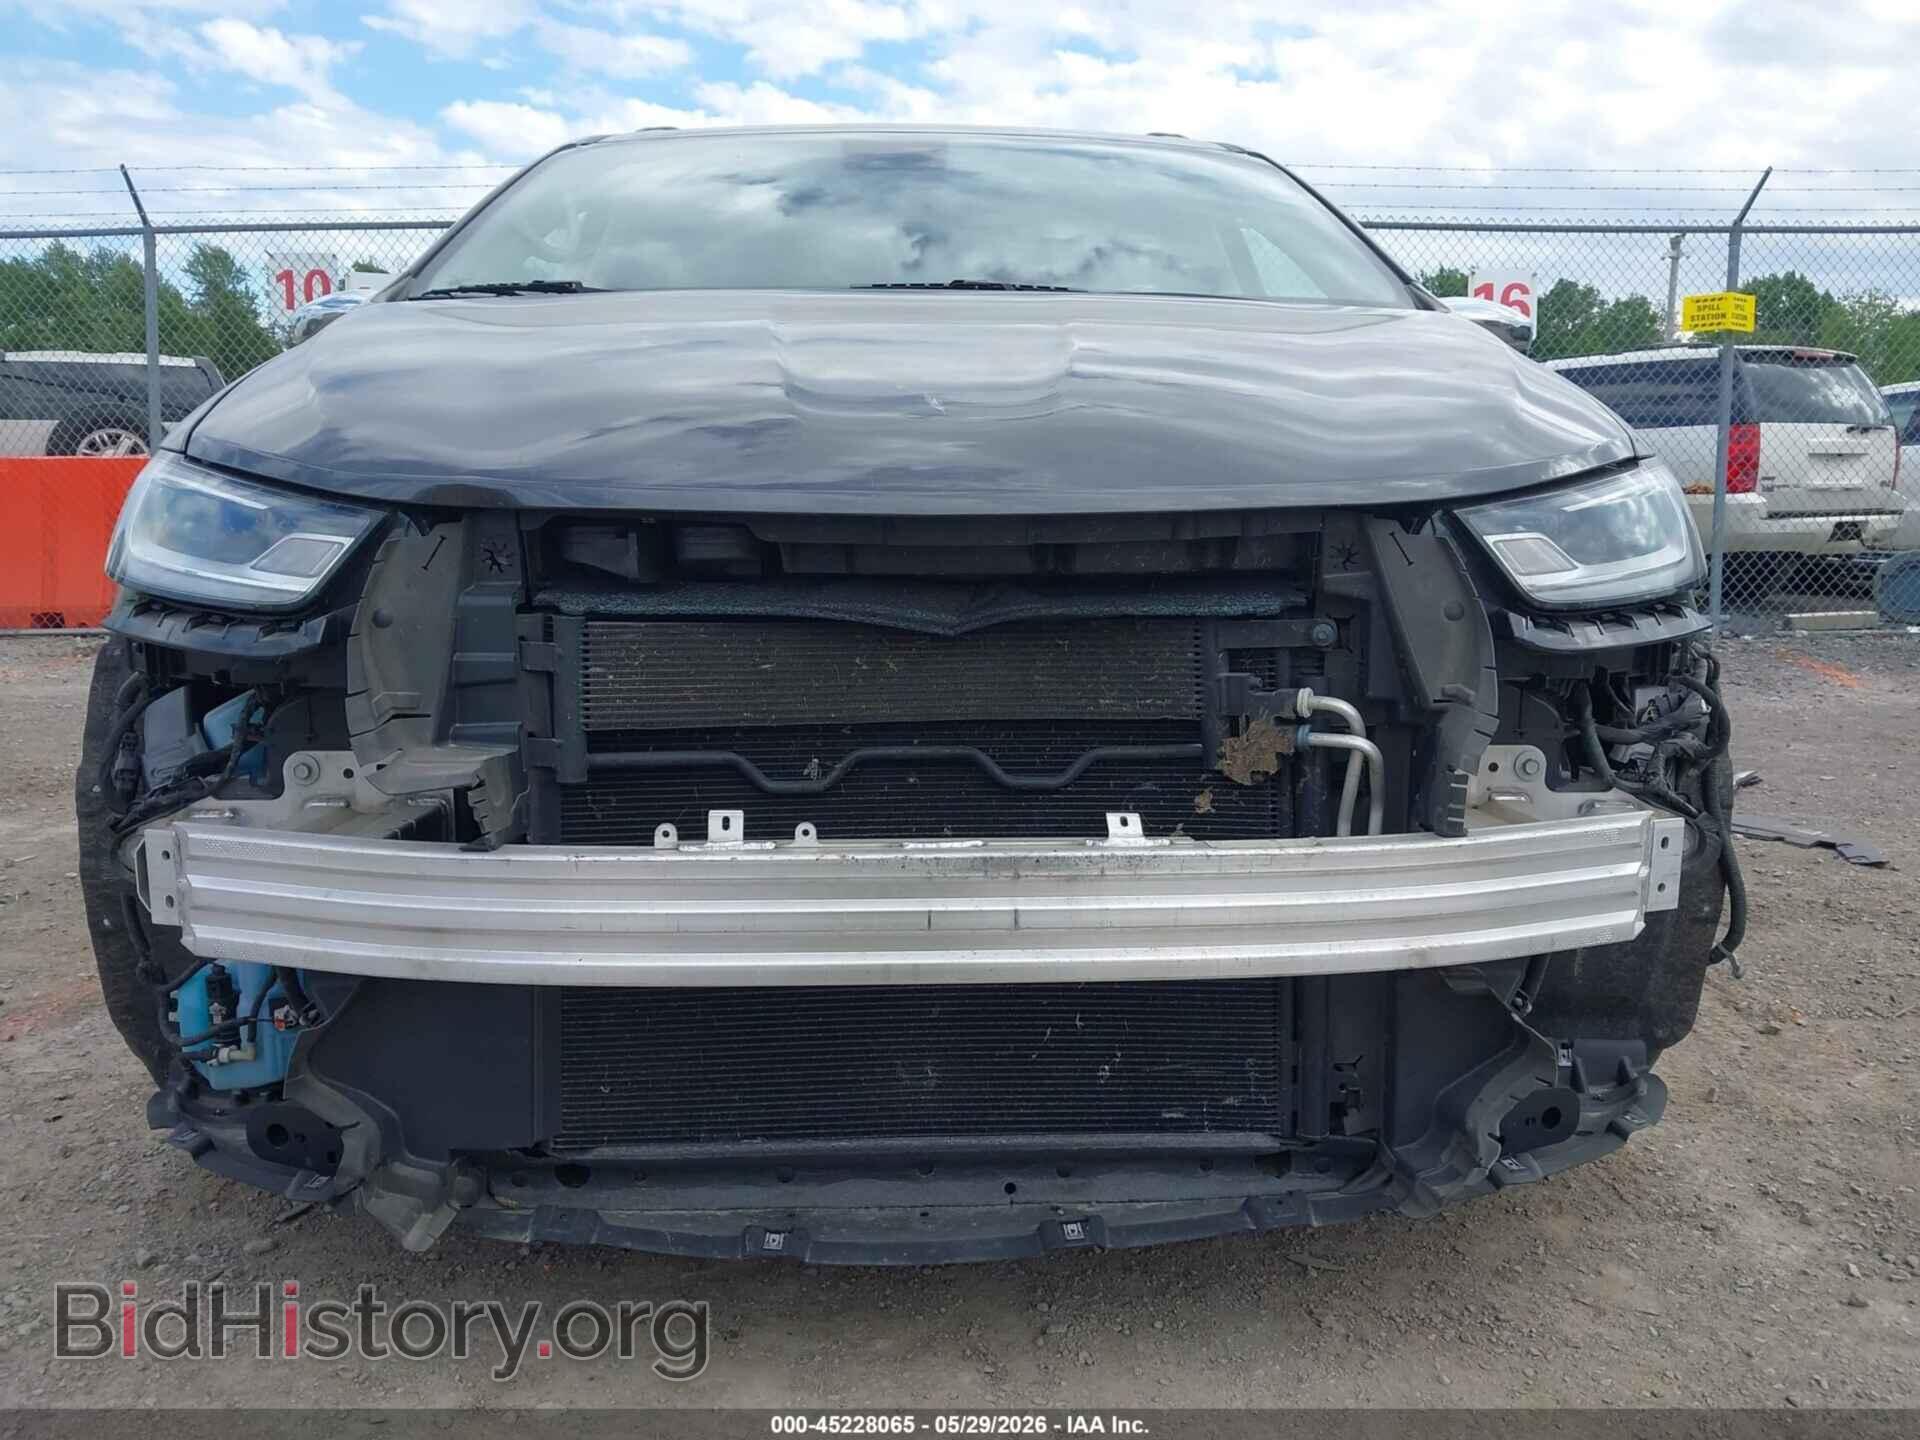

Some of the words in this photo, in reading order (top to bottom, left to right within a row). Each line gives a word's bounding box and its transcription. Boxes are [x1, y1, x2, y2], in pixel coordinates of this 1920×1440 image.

[276, 269, 331, 310] 10
[1696, 303, 1721, 313] SPILL
[1690, 312, 1727, 322] STATION
